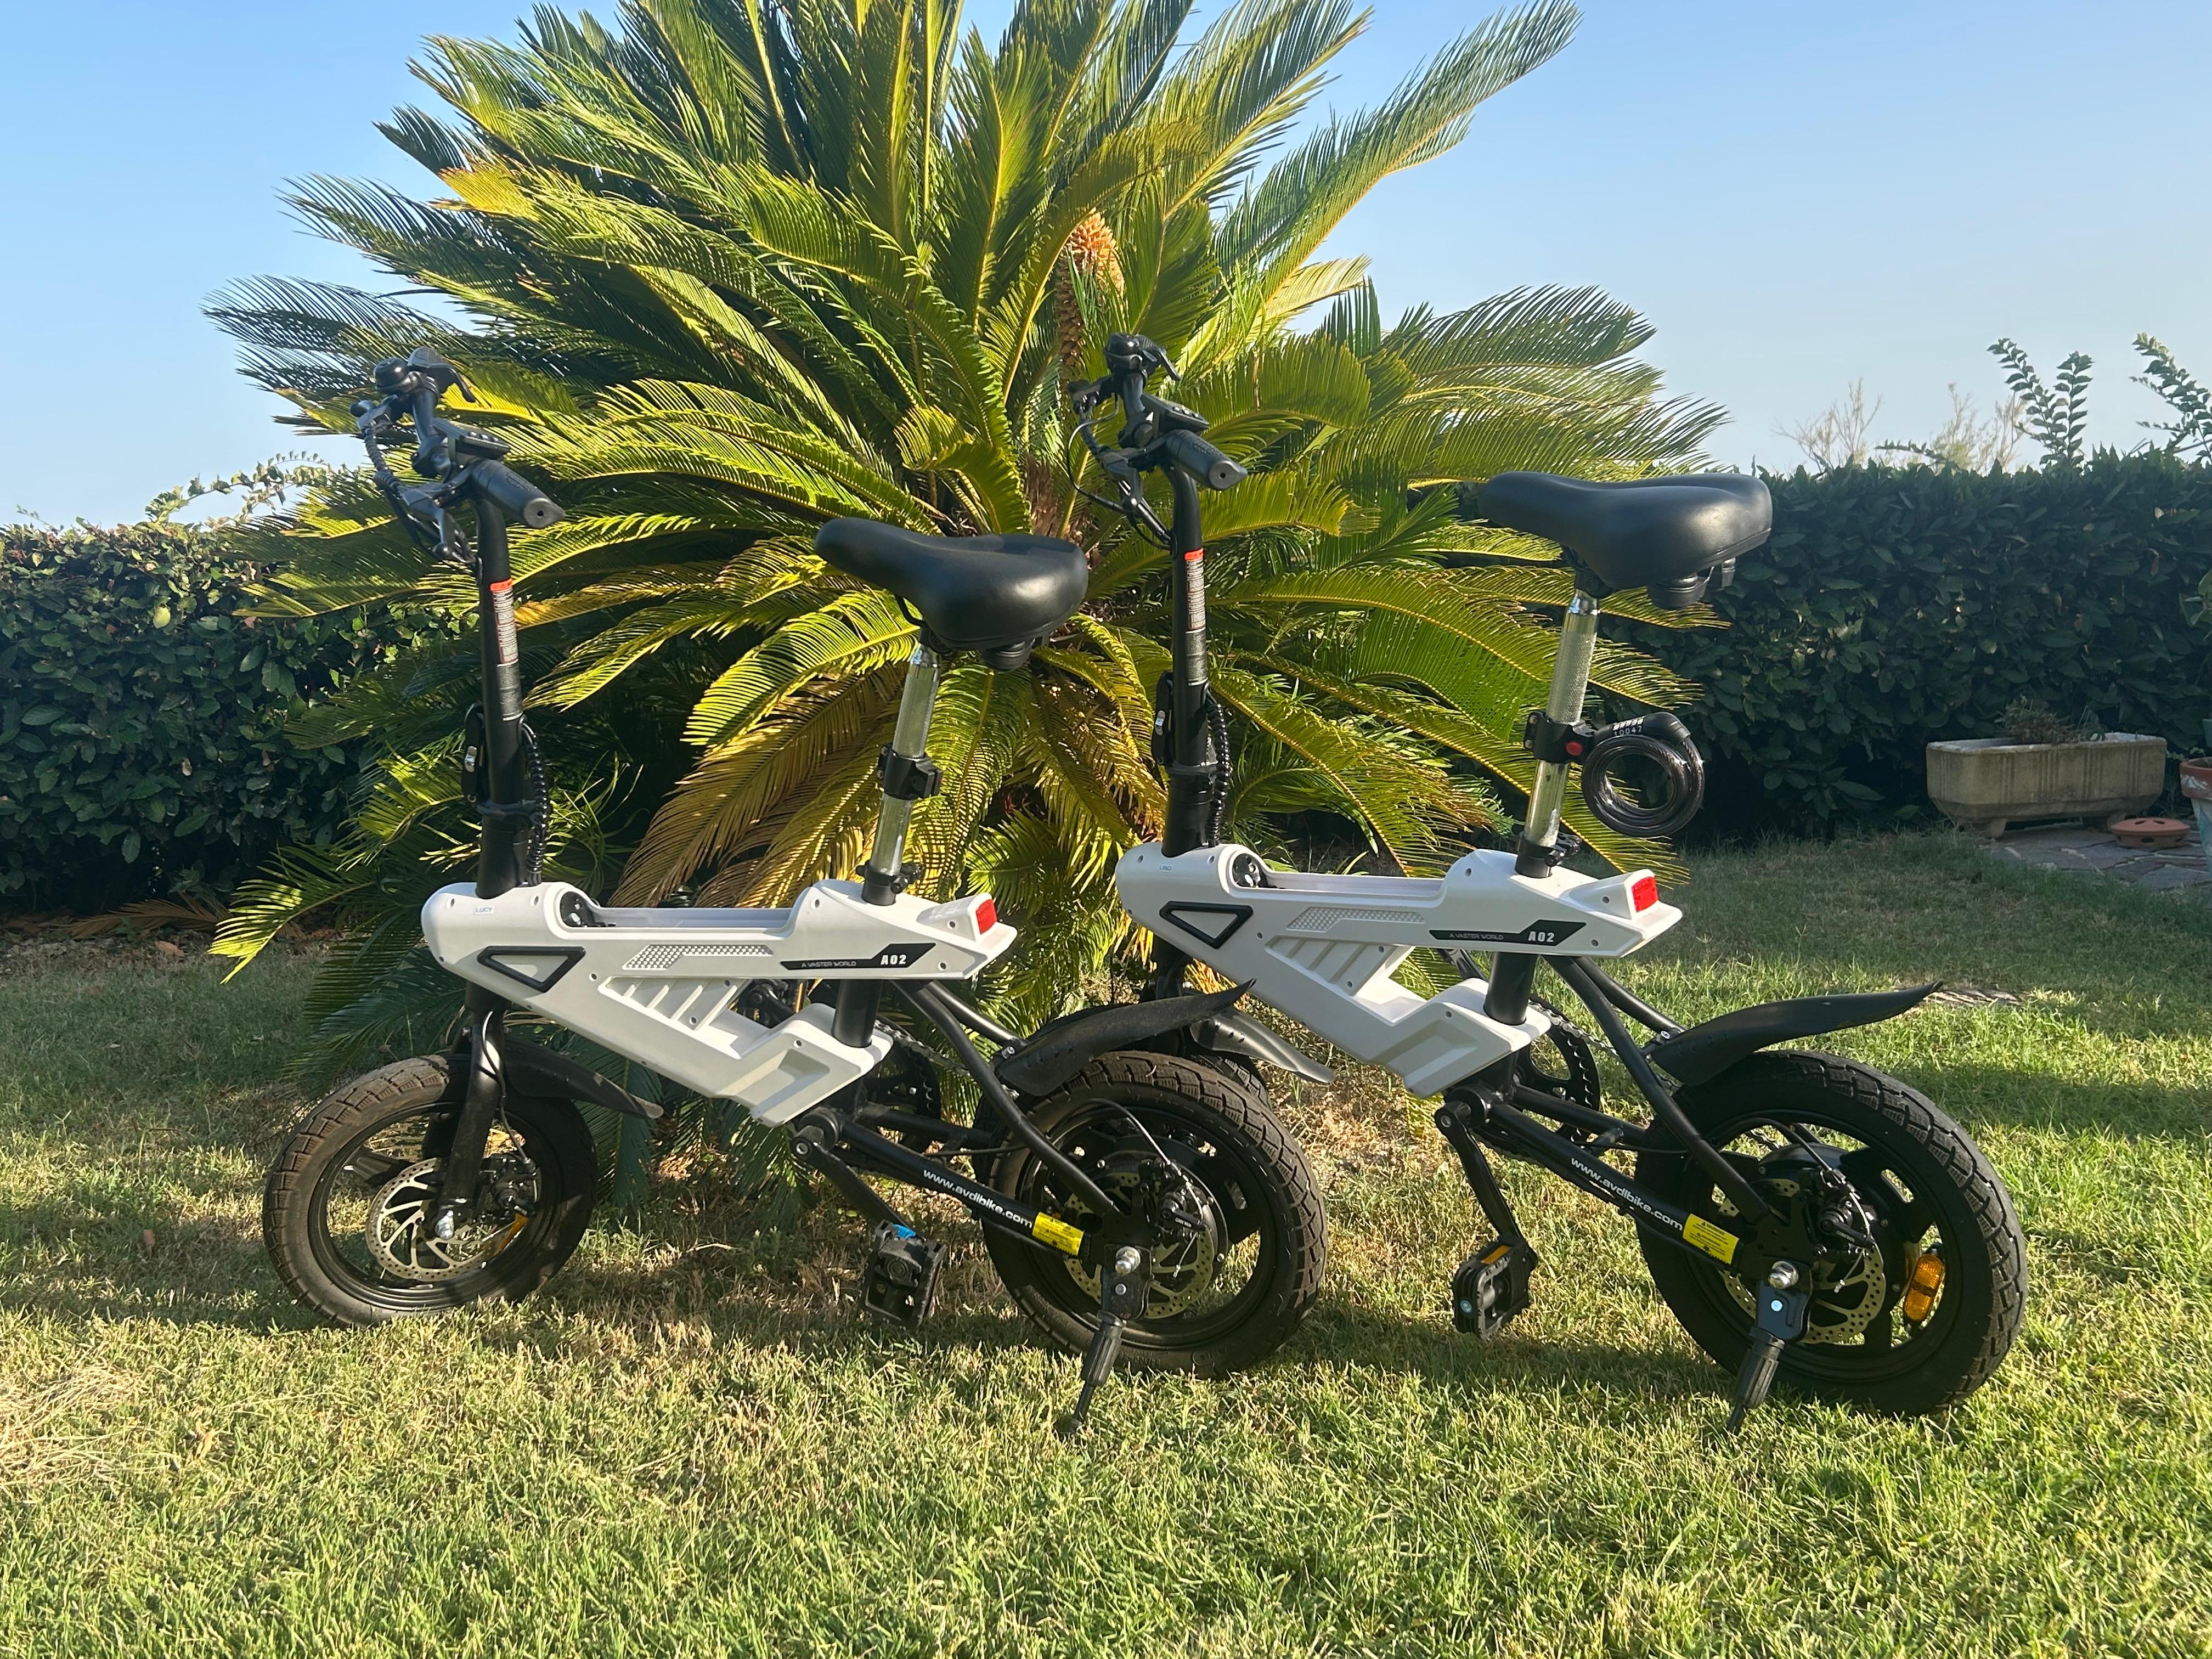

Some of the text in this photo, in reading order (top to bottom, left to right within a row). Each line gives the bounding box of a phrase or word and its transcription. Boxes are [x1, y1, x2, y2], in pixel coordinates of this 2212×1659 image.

[1528, 931, 1555, 943] A02
[881, 954, 907, 966] A02
[923, 1169, 1034, 1229] www.avdlbike.com
[1571, 1157, 1683, 1231] www.avdlbike.com
